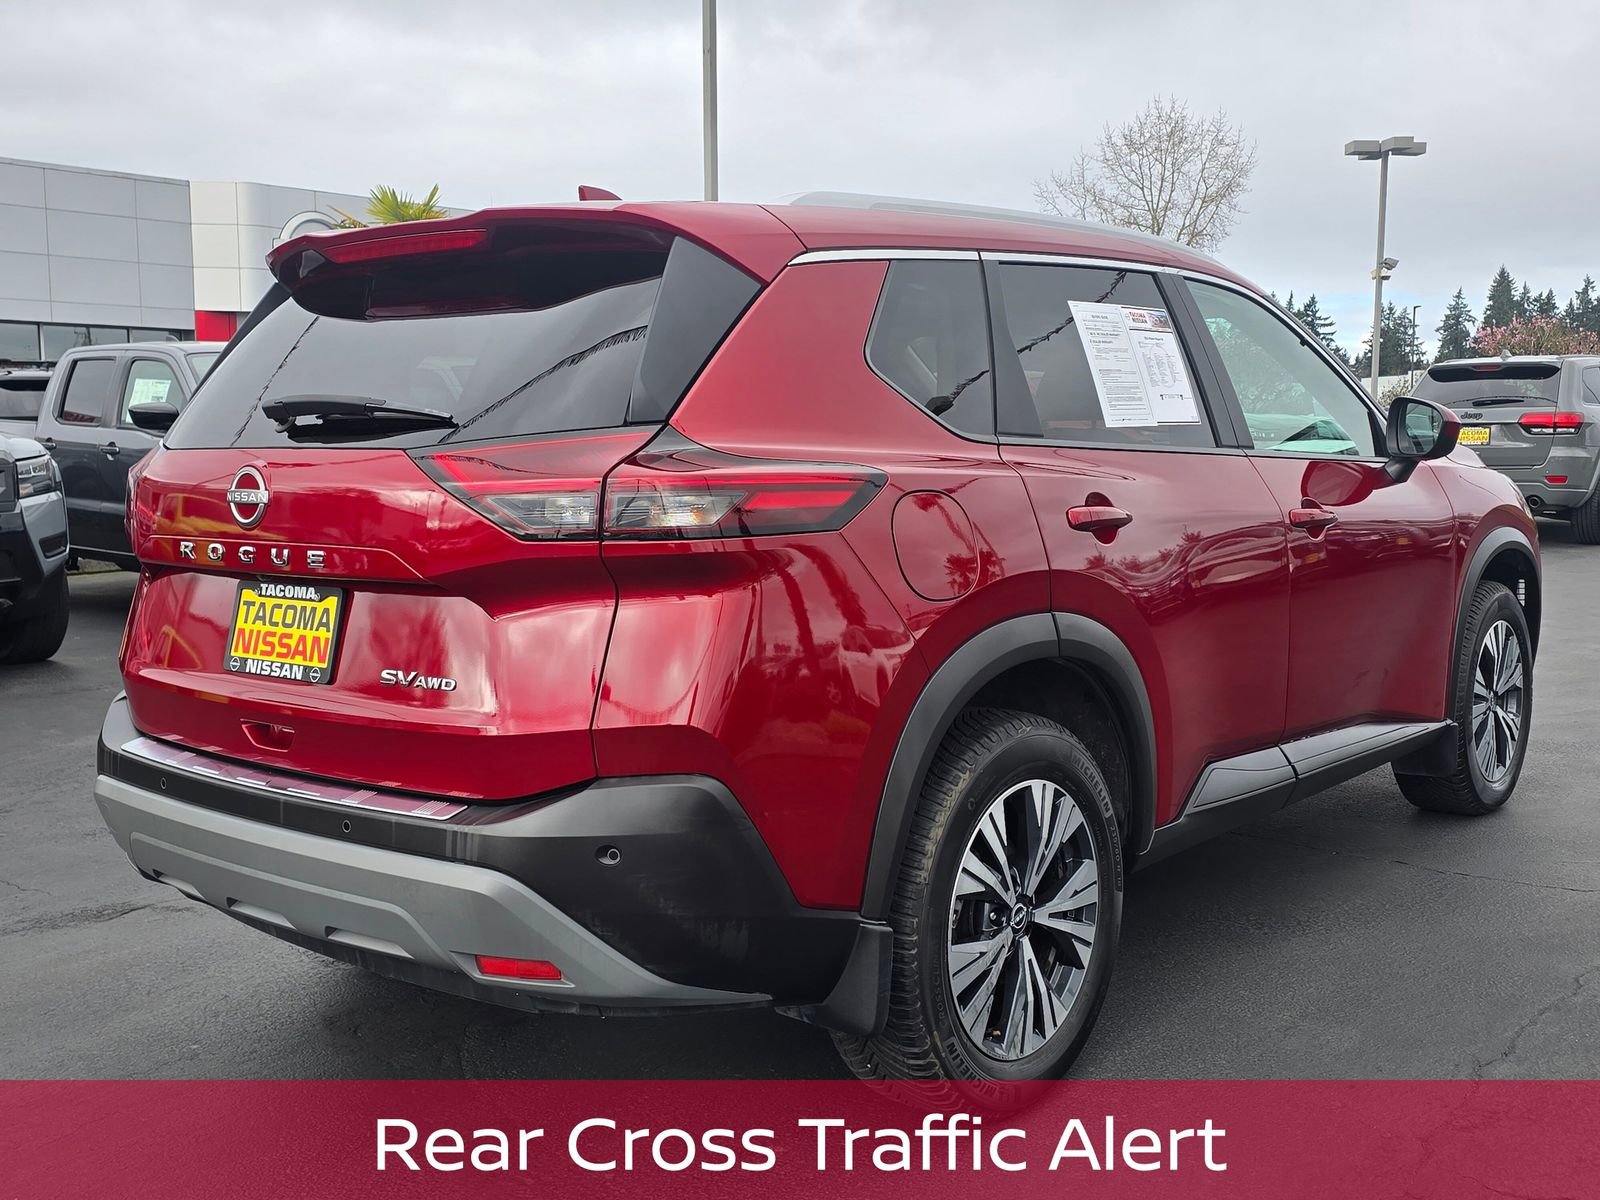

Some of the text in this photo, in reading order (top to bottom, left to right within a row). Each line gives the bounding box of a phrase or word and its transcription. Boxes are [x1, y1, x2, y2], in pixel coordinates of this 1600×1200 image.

[1460, 411, 1484, 421] Jeep
[227, 490, 268, 503] NISSAN
[180, 541, 326, 568] ROGUE
[260, 583, 315, 600] TACOMA
[242, 600, 331, 633] TACOMA
[234, 628, 331, 665] NISSAN
[245, 659, 304, 680] NISSAN
[1071, 754, 1111, 814] MICHELIN
